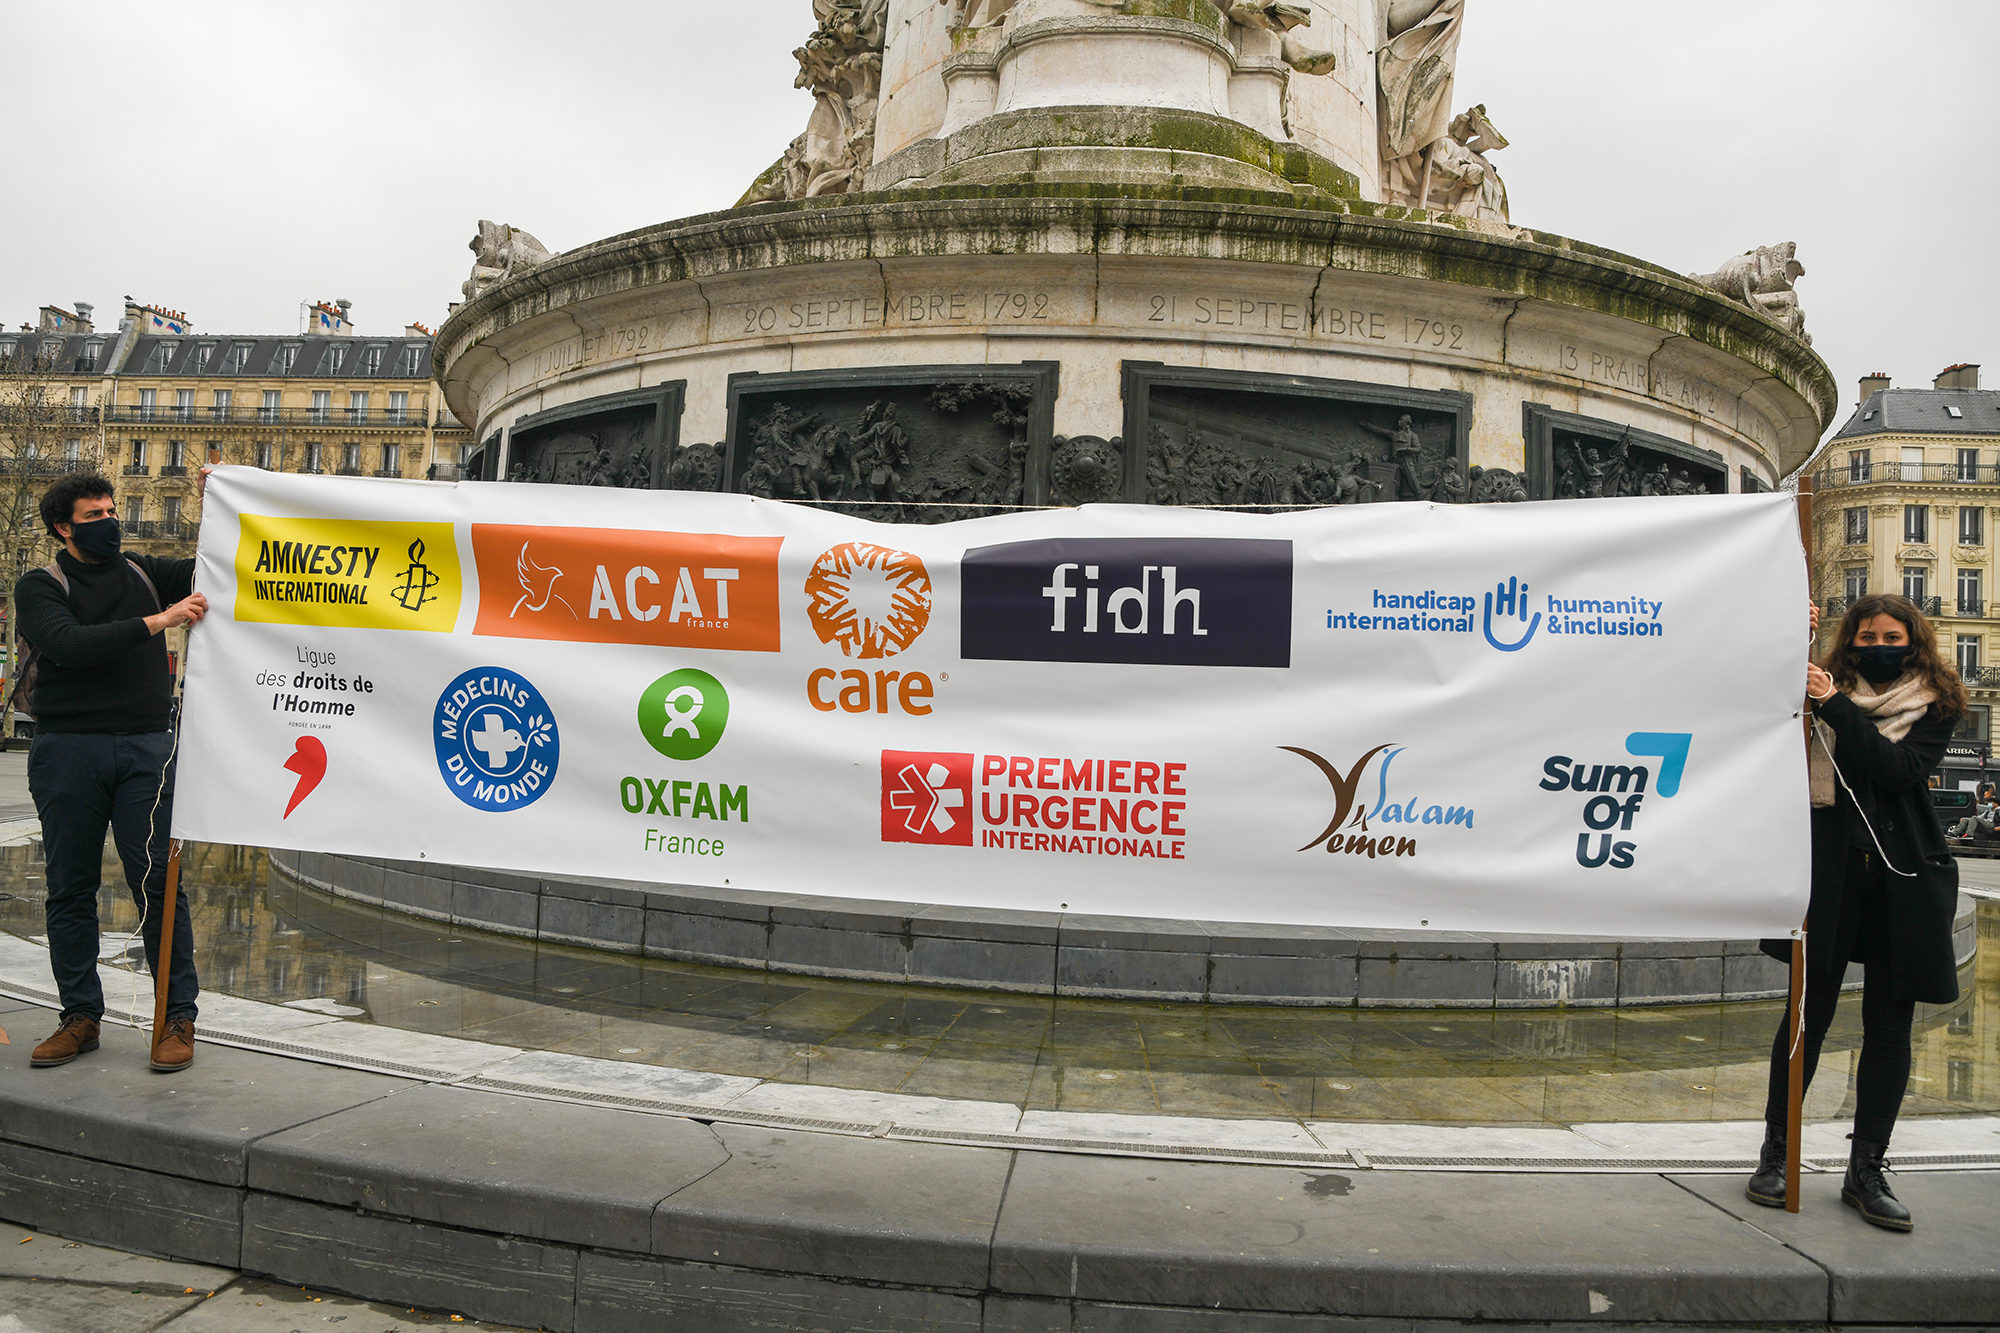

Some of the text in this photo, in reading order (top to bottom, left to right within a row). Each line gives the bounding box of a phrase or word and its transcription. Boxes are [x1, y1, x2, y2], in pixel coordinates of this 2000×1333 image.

[742, 293, 1050, 333] 20 SEPTEMBRE 1792
[1147, 295, 1464, 351] 21 SEPTEMBRE 1792
[609, 326, 649, 356] 1792
[1558, 344, 1579, 371] 13
[255, 540, 380, 578] AMNESTY
[254, 580, 368, 605] INTERNATIONAL
[588, 564, 740, 623] ACAT
[1042, 563, 1208, 636] fidh
[1373, 589, 1476, 615] handicap
[1547, 594, 1663, 620] humanity
[687, 617, 729, 629] france
[1326, 609, 1474, 633] international
[296, 646, 337, 669] Ligue
[256, 669, 374, 694] des droits de
[806, 667, 934, 716] care
[441, 676, 530, 741] MÉDECINS
[446, 753, 550, 804] DU MONDE
[981, 754, 1187, 796] PREMIERE
[1367, 746, 1475, 830] Salam
[1538, 755, 1649, 793] Sum
[620, 776, 749, 823] OXFAM
[981, 792, 1186, 836] URGENCE
[1276, 743, 1417, 859] Yemen
[1583, 794, 1644, 830] Of
[644, 829, 725, 857] France
[982, 829, 1186, 860] INTERNATIONALE
[1576, 832, 1638, 868] Us
